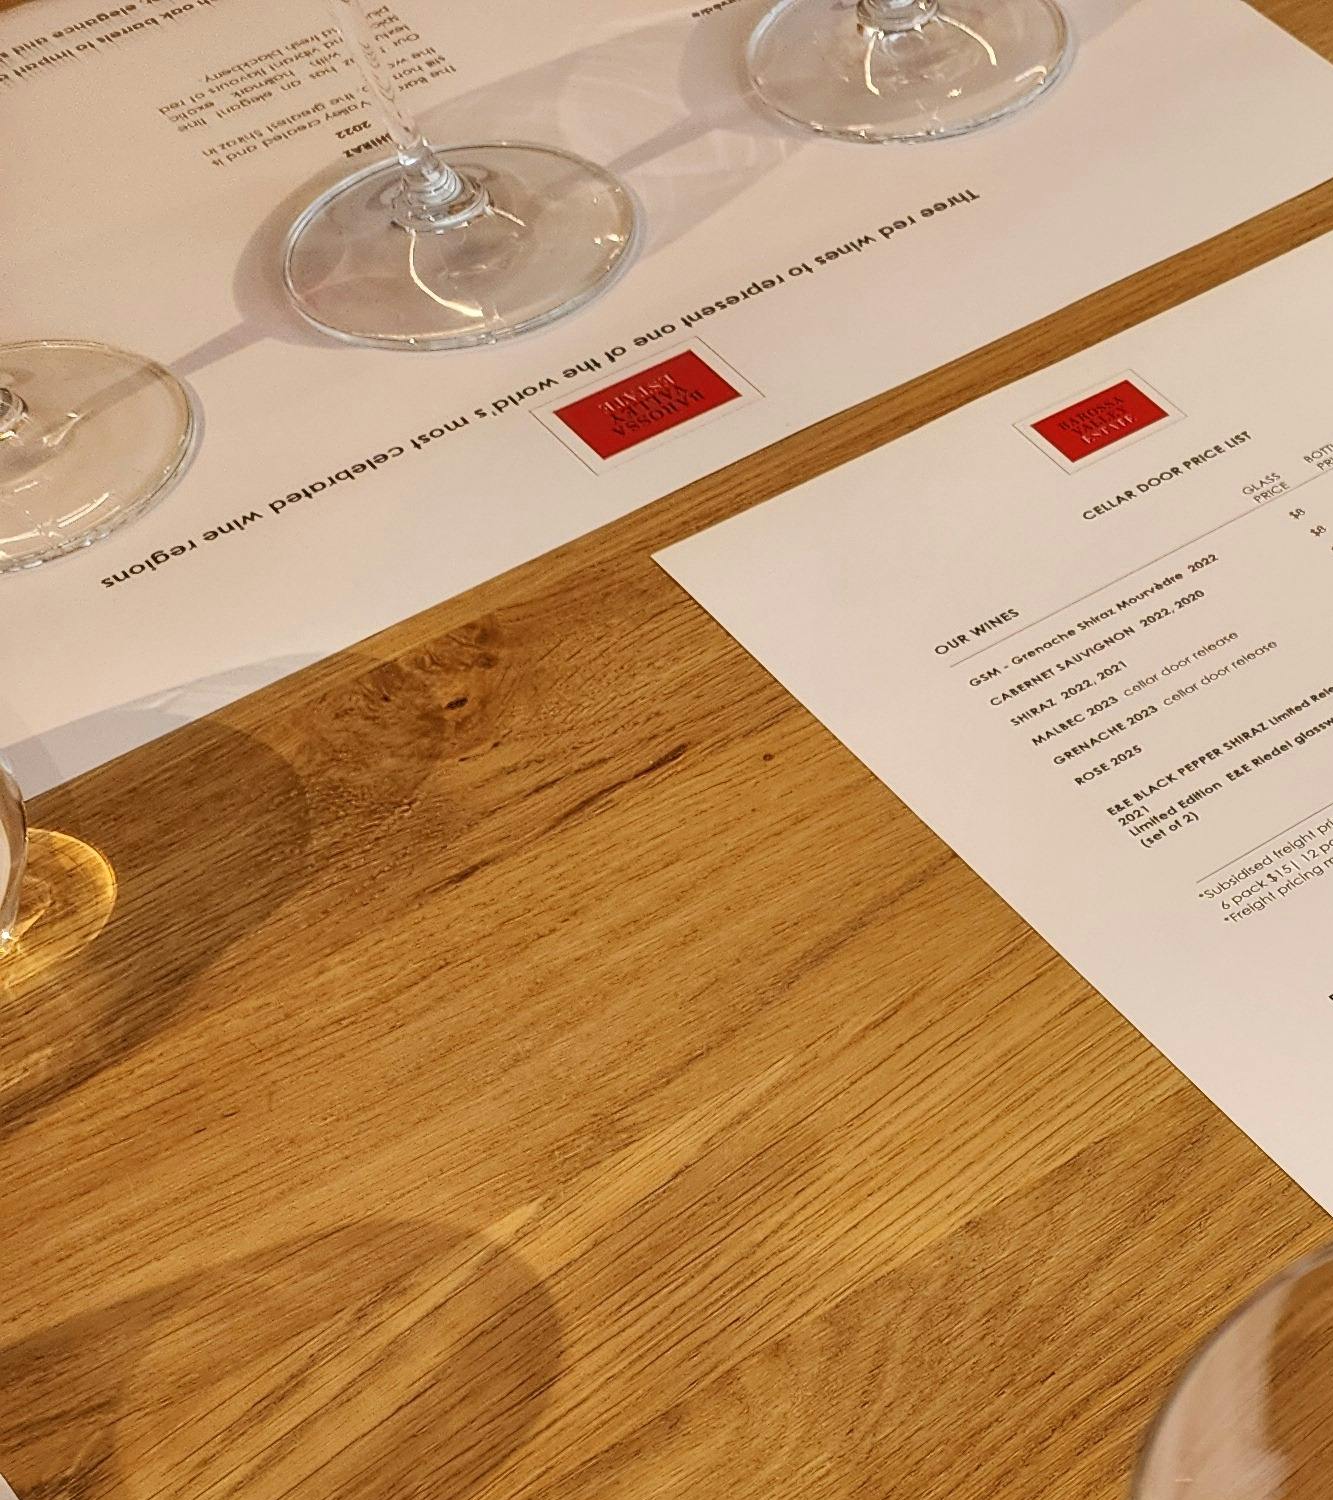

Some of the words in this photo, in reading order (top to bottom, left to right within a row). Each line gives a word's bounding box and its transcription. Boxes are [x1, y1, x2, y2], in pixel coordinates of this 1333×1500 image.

[918, 188, 981, 218] Three
[876, 214, 917, 240] red
[787, 261, 814, 277] to
[813, 233, 877, 266] wines
[679, 273, 786, 329] represent
[602, 344, 627, 364] of
[631, 323, 677, 347] one
[560, 356, 603, 379] the
[472, 376, 560, 419] world's
[598, 373, 675, 414] ESTATE
[612, 382, 690, 425] VALLEY
[612, 389, 705, 438] BAROSSA
[1058, 395, 1126, 432] BAROSSA
[408, 414, 471, 450] most
[1081, 414, 1137, 445] ESTATE
[267, 445, 405, 515] celebrated
[1081, 489, 1138, 520] CELLAR
[1135, 465, 1184, 493] DOOR
[1181, 443, 1226, 470] PRICE
[1223, 429, 1252, 449] LIST
[201, 510, 264, 542] wine
[99, 538, 198, 589] regions
[933, 633, 971, 655] OUR
[967, 607, 1020, 637] WINES
[968, 666, 1002, 687] GSM
[1010, 628, 1077, 665] Grenache
[1075, 607, 1117, 631] Shiraz
[1114, 572, 1184, 611] Mourvèdre
[1186, 553, 1219, 574] 2022
[989, 667, 1056, 706] CABERNET
[1054, 624, 1136, 672] SAUVIGNON
[1138, 606, 1175, 628] 2022,
[1173, 588, 1205, 610] 2020
[1009, 697, 1058, 727] SHIRAZ
[1059, 678, 1098, 701] 2022,
[1095, 659, 1128, 681] 2021
[1105, 797, 1134, 816] E&E
[1131, 772, 1179, 802] BLACK
[1175, 746, 1224, 777] PEPPER
[1221, 721, 1269, 751] SHIRAZ
[1266, 698, 1311, 726] Limited
